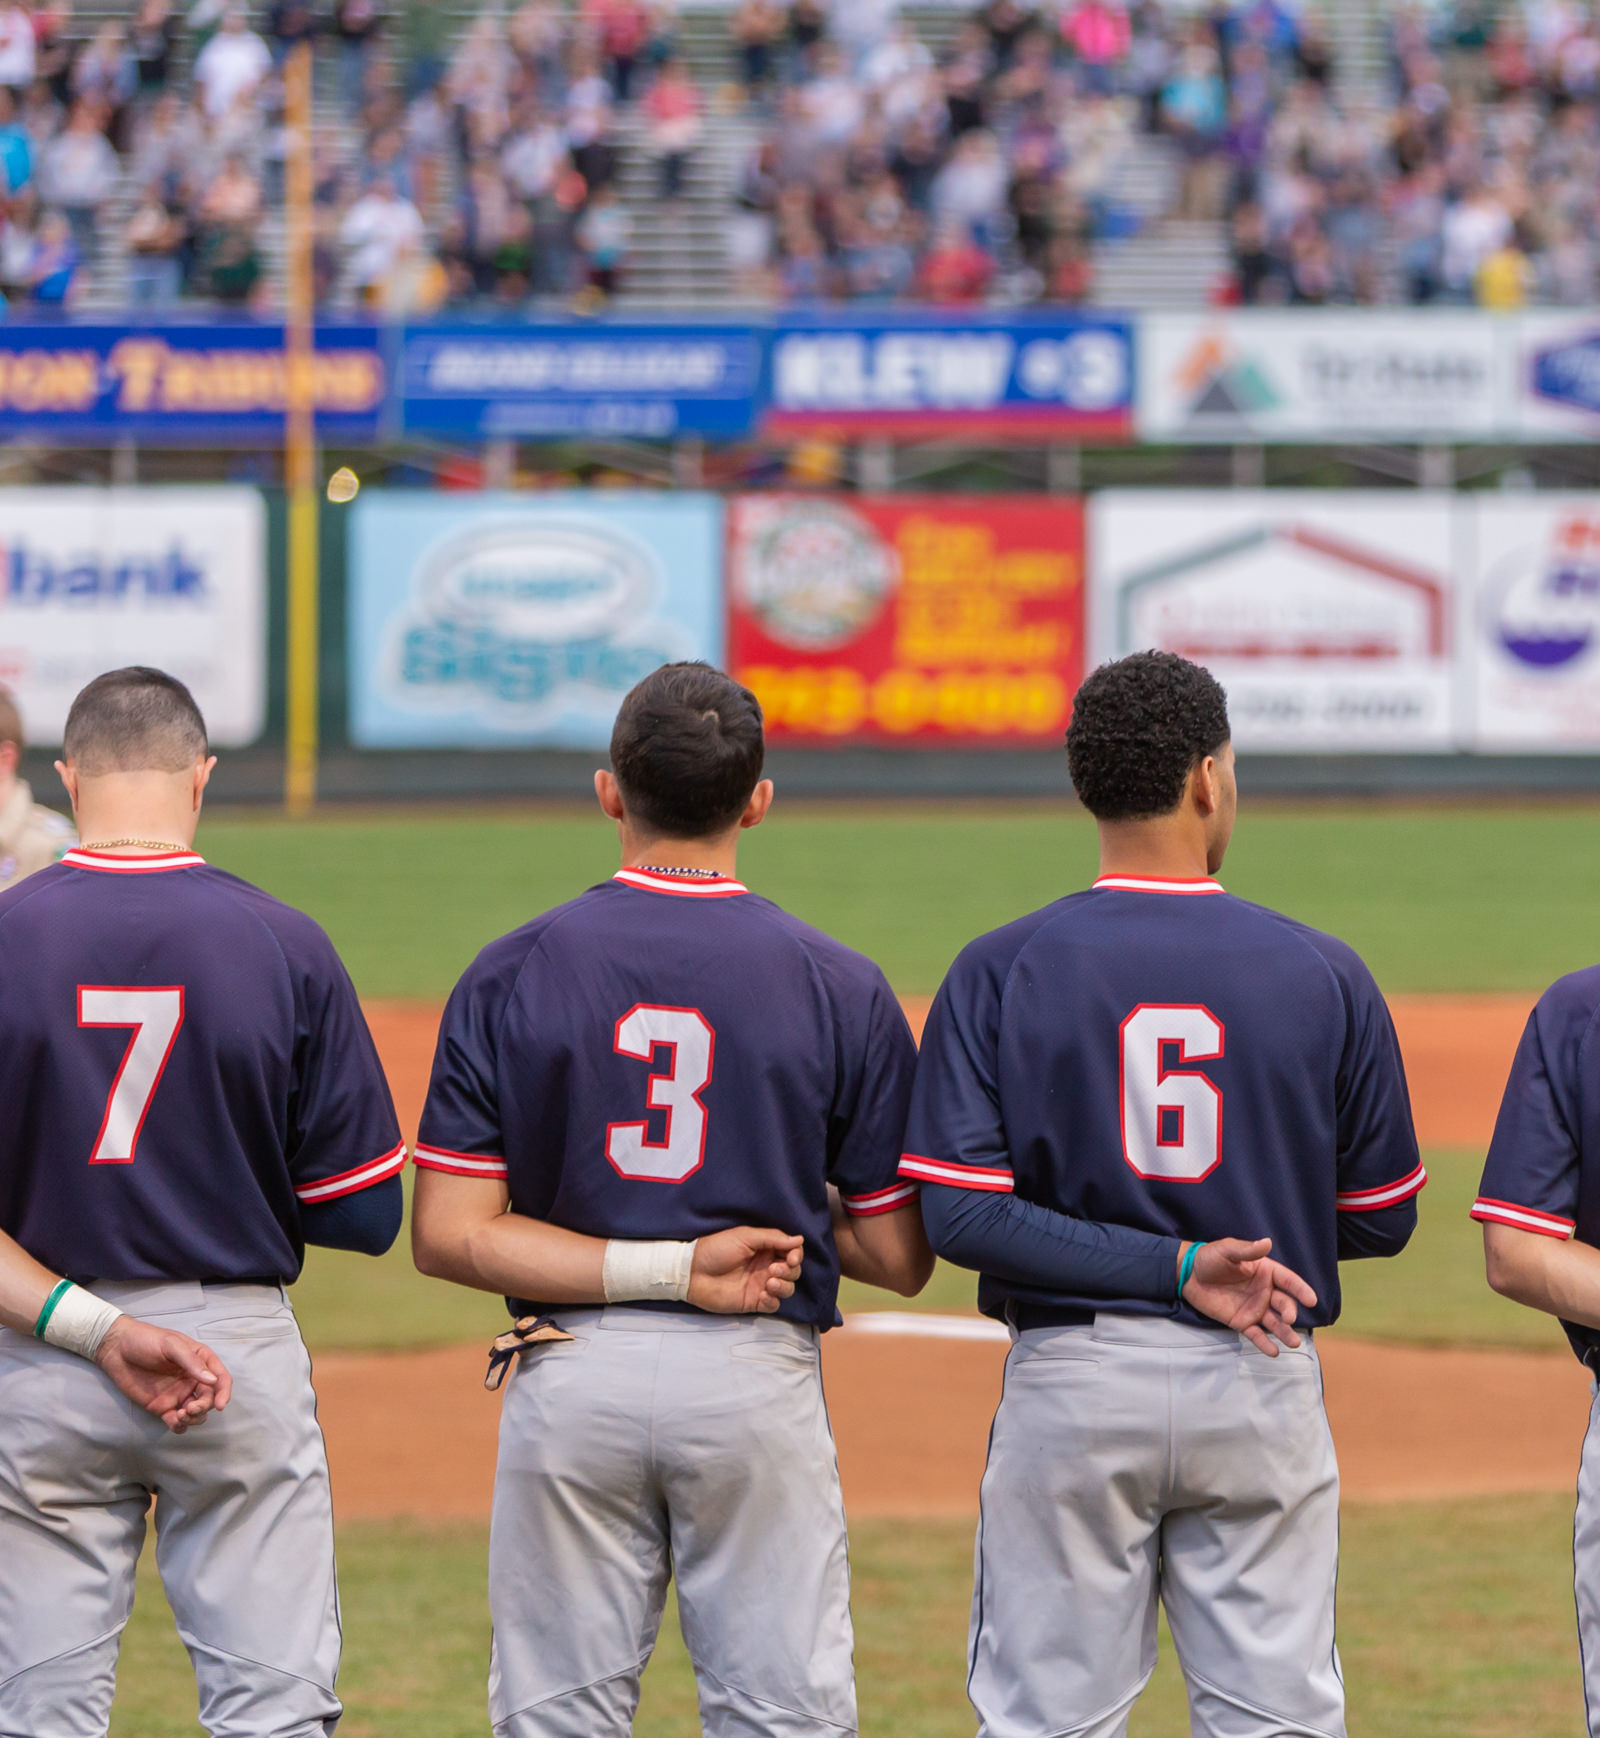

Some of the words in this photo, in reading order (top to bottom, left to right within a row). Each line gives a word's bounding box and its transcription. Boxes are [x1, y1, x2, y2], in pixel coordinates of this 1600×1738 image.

[77, 984, 185, 1164] 7
[604, 1002, 716, 1184] 3
[1118, 1003, 1226, 1184] 6
